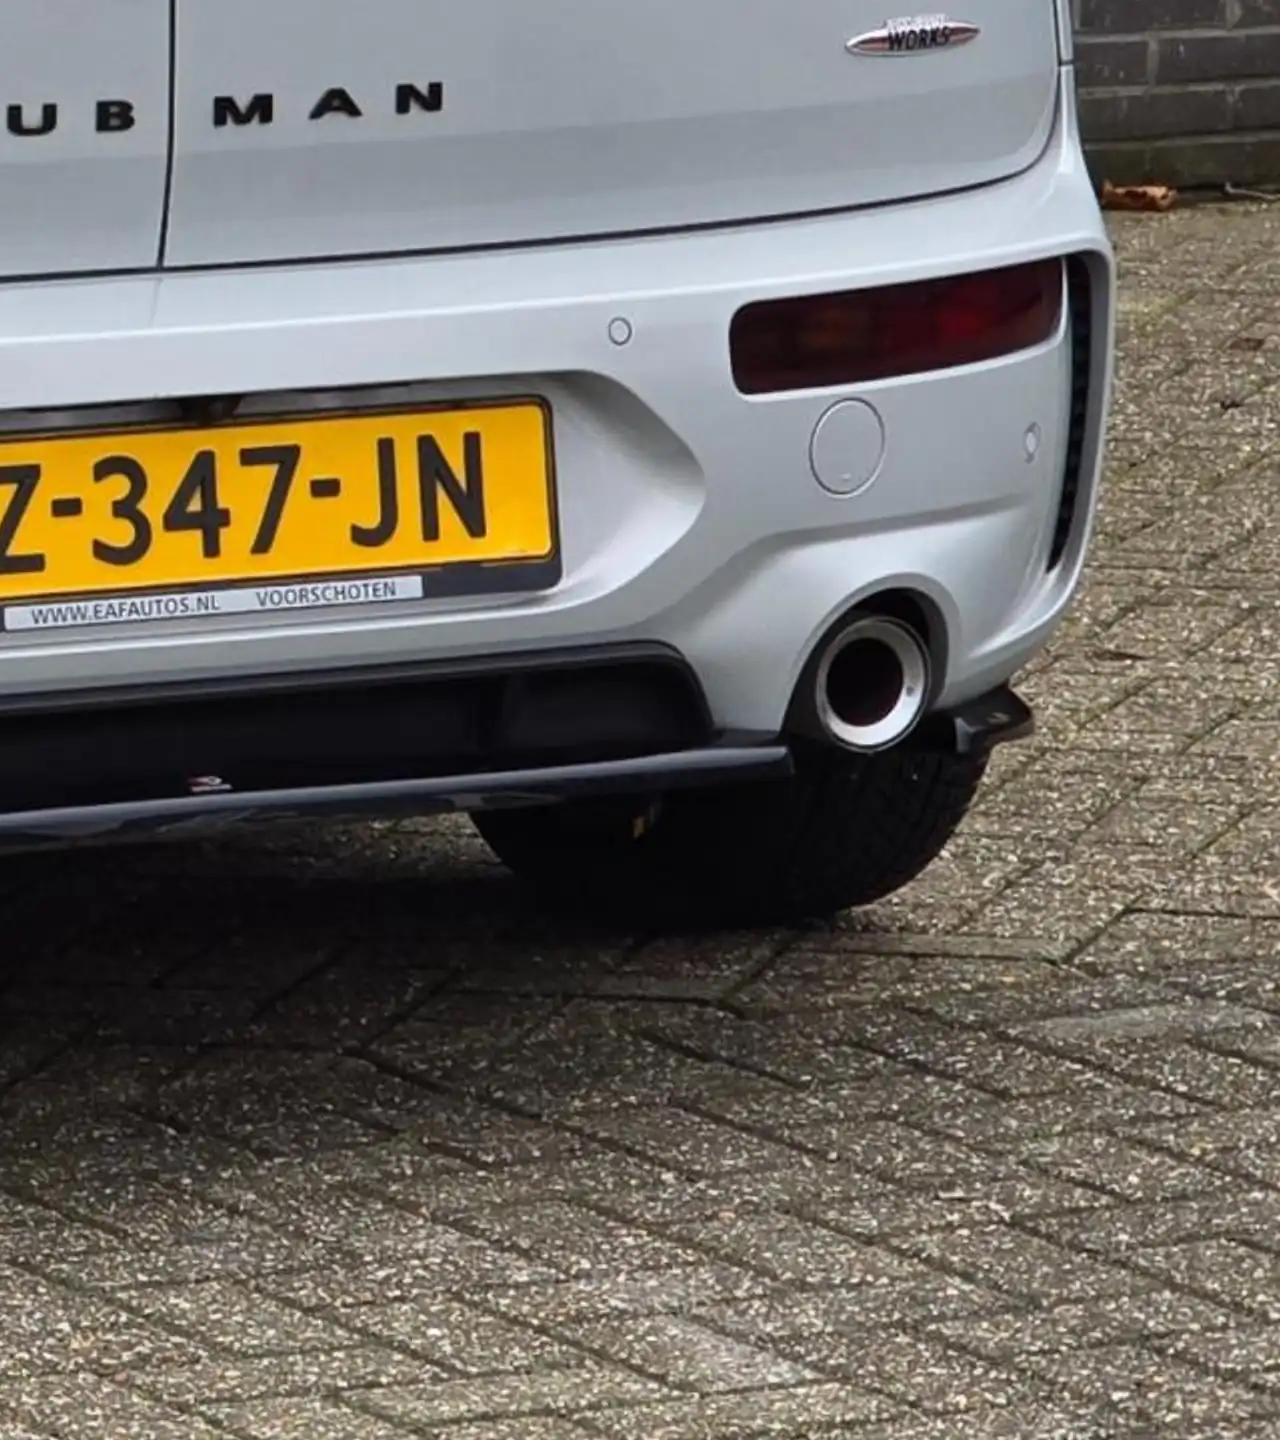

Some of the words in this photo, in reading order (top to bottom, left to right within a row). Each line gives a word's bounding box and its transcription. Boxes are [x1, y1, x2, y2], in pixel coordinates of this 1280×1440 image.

[889, 26, 950, 50] WORKS
[31, 596, 220, 625] WWW.EAFAUTOS.NL
[256, 582, 396, 608] VOORSCHOTEN
